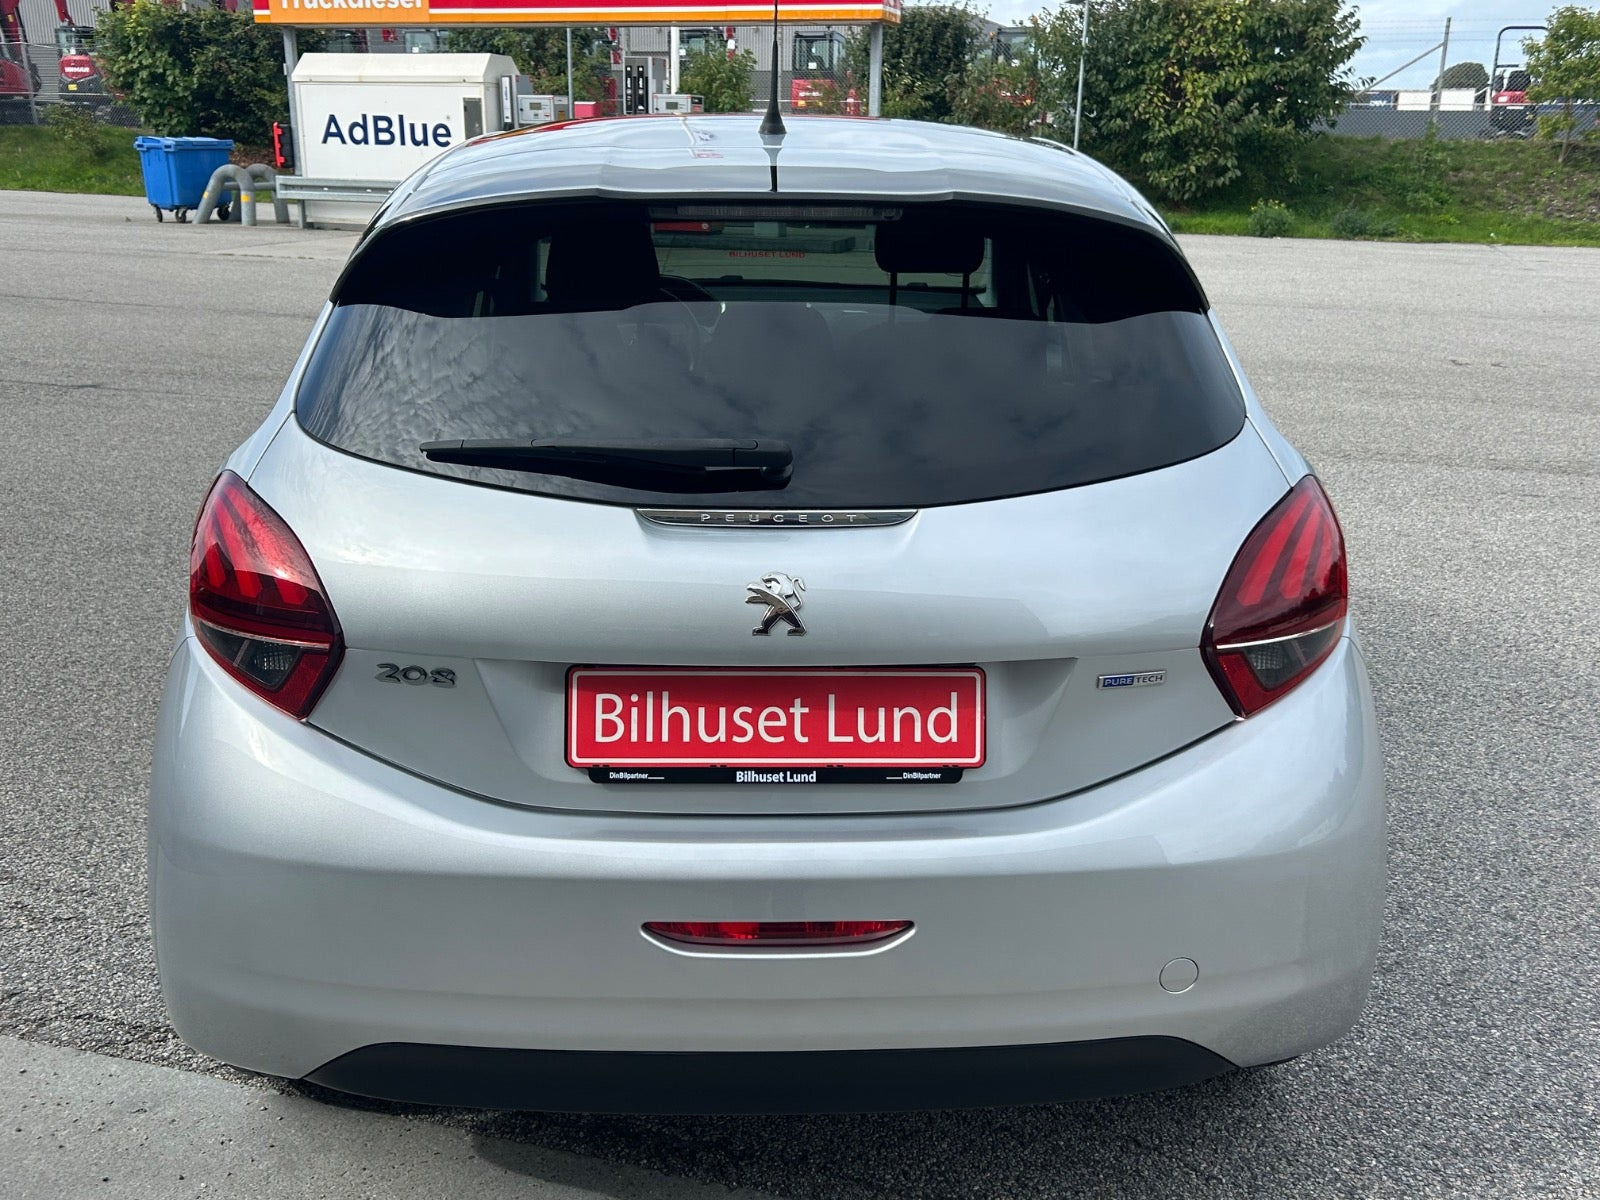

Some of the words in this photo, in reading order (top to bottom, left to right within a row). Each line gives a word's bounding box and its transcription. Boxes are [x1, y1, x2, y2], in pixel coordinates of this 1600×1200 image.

[321, 113, 452, 148] AdBlue
[700, 512, 858, 523] PEUGEOT
[374, 662, 457, 689] 208
[594, 690, 810, 744] Bilhuset
[827, 691, 959, 744] Lund
[735, 770, 785, 783] Bilhuset
[786, 770, 817, 783] Lund
